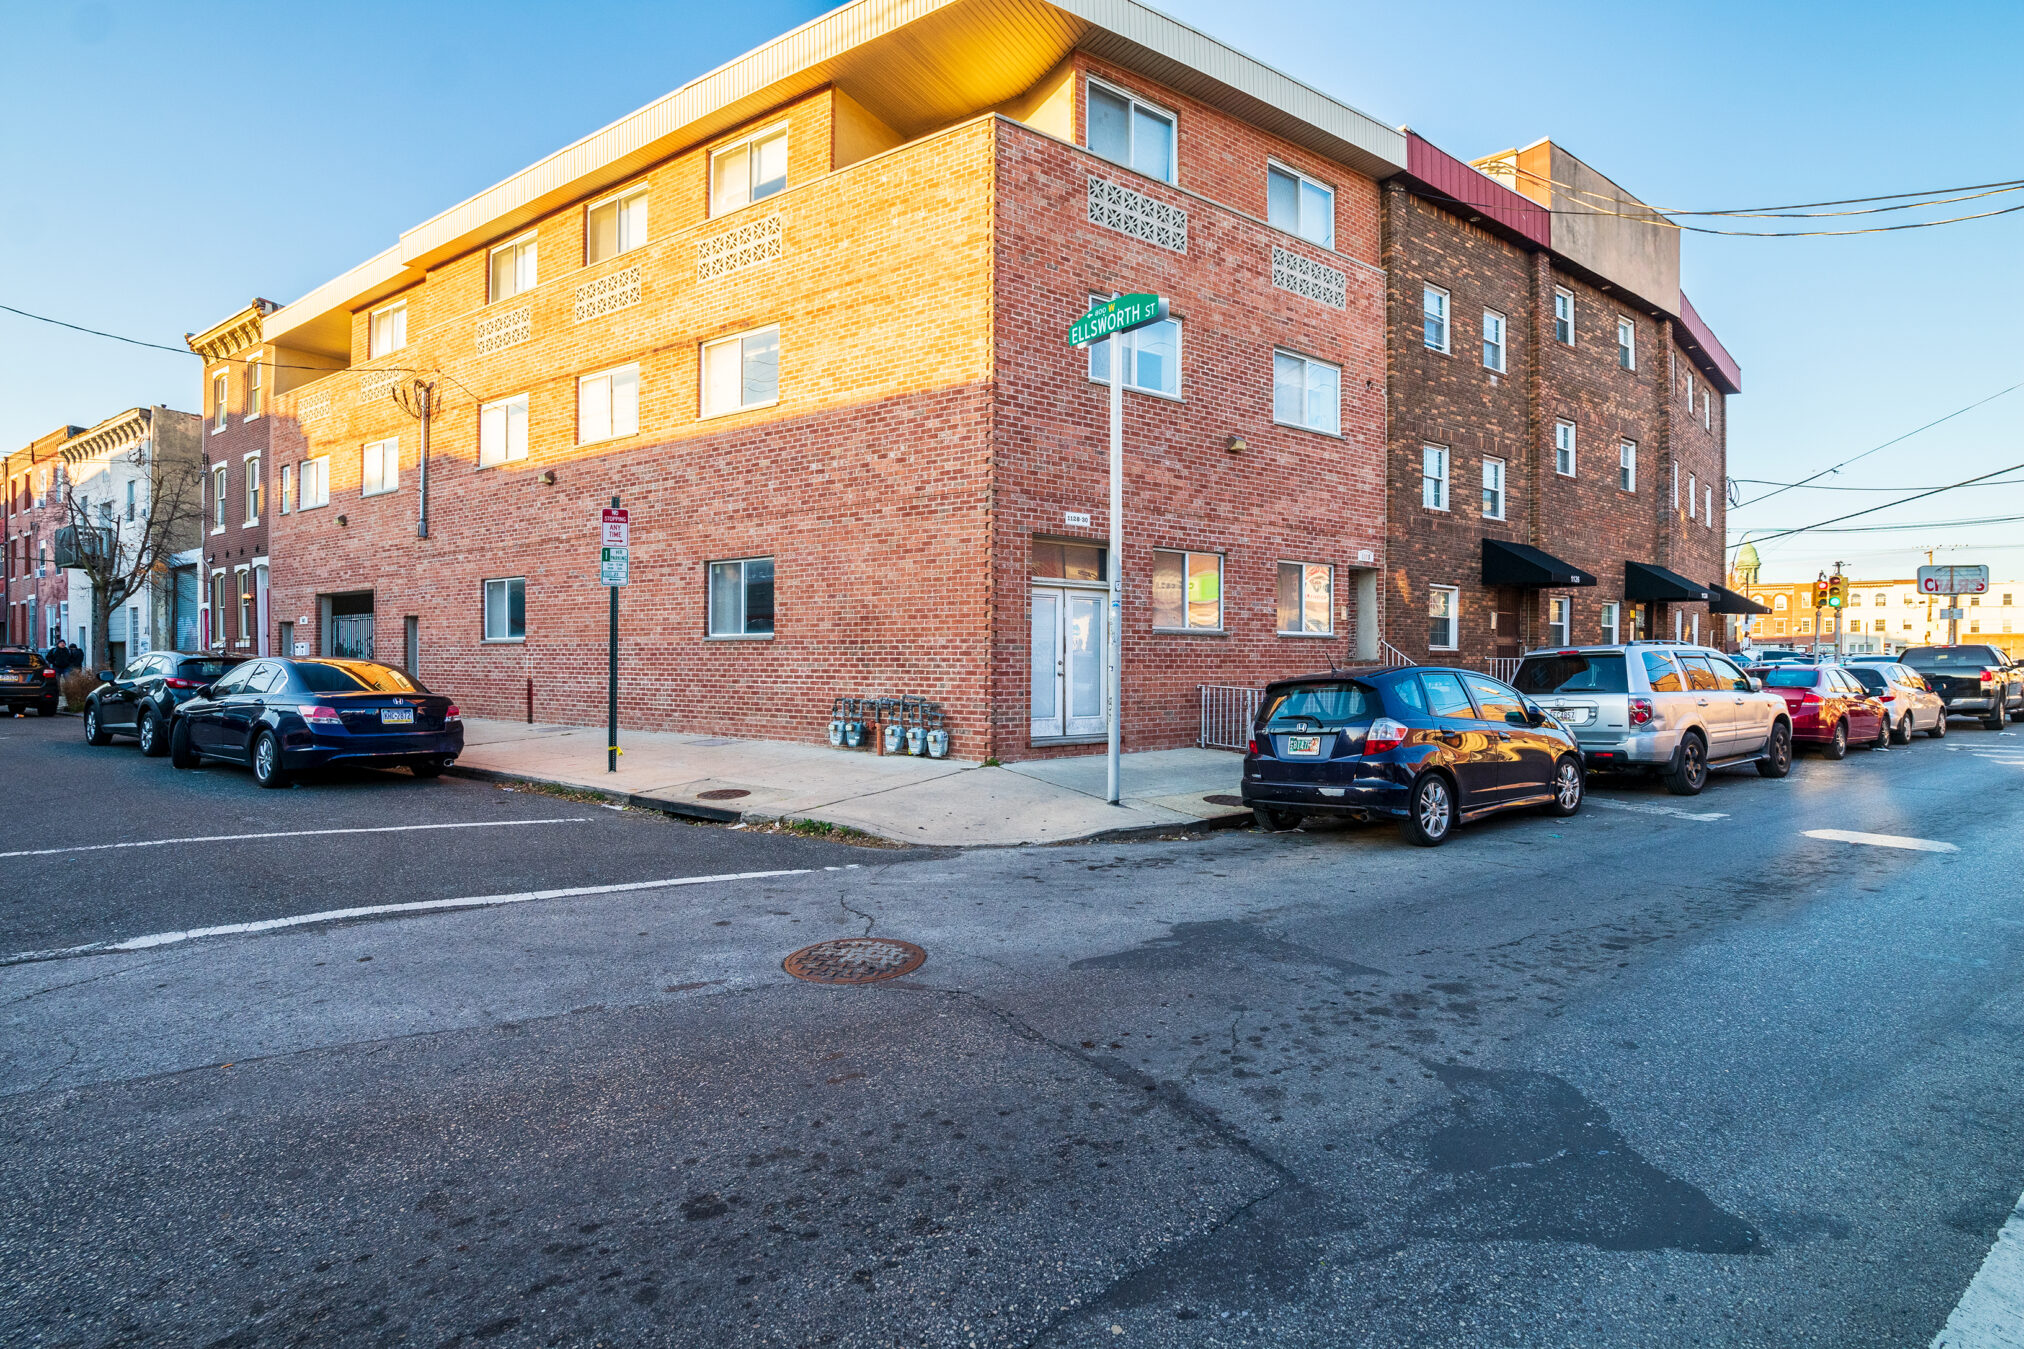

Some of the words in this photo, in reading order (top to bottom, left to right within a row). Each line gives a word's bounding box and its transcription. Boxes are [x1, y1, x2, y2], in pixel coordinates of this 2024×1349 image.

[1071, 303, 1140, 344] ELLSWORTH
[1145, 302, 1156, 317] ST
[1094, 307, 1107, 317] 800
[1108, 302, 1116, 313] W
